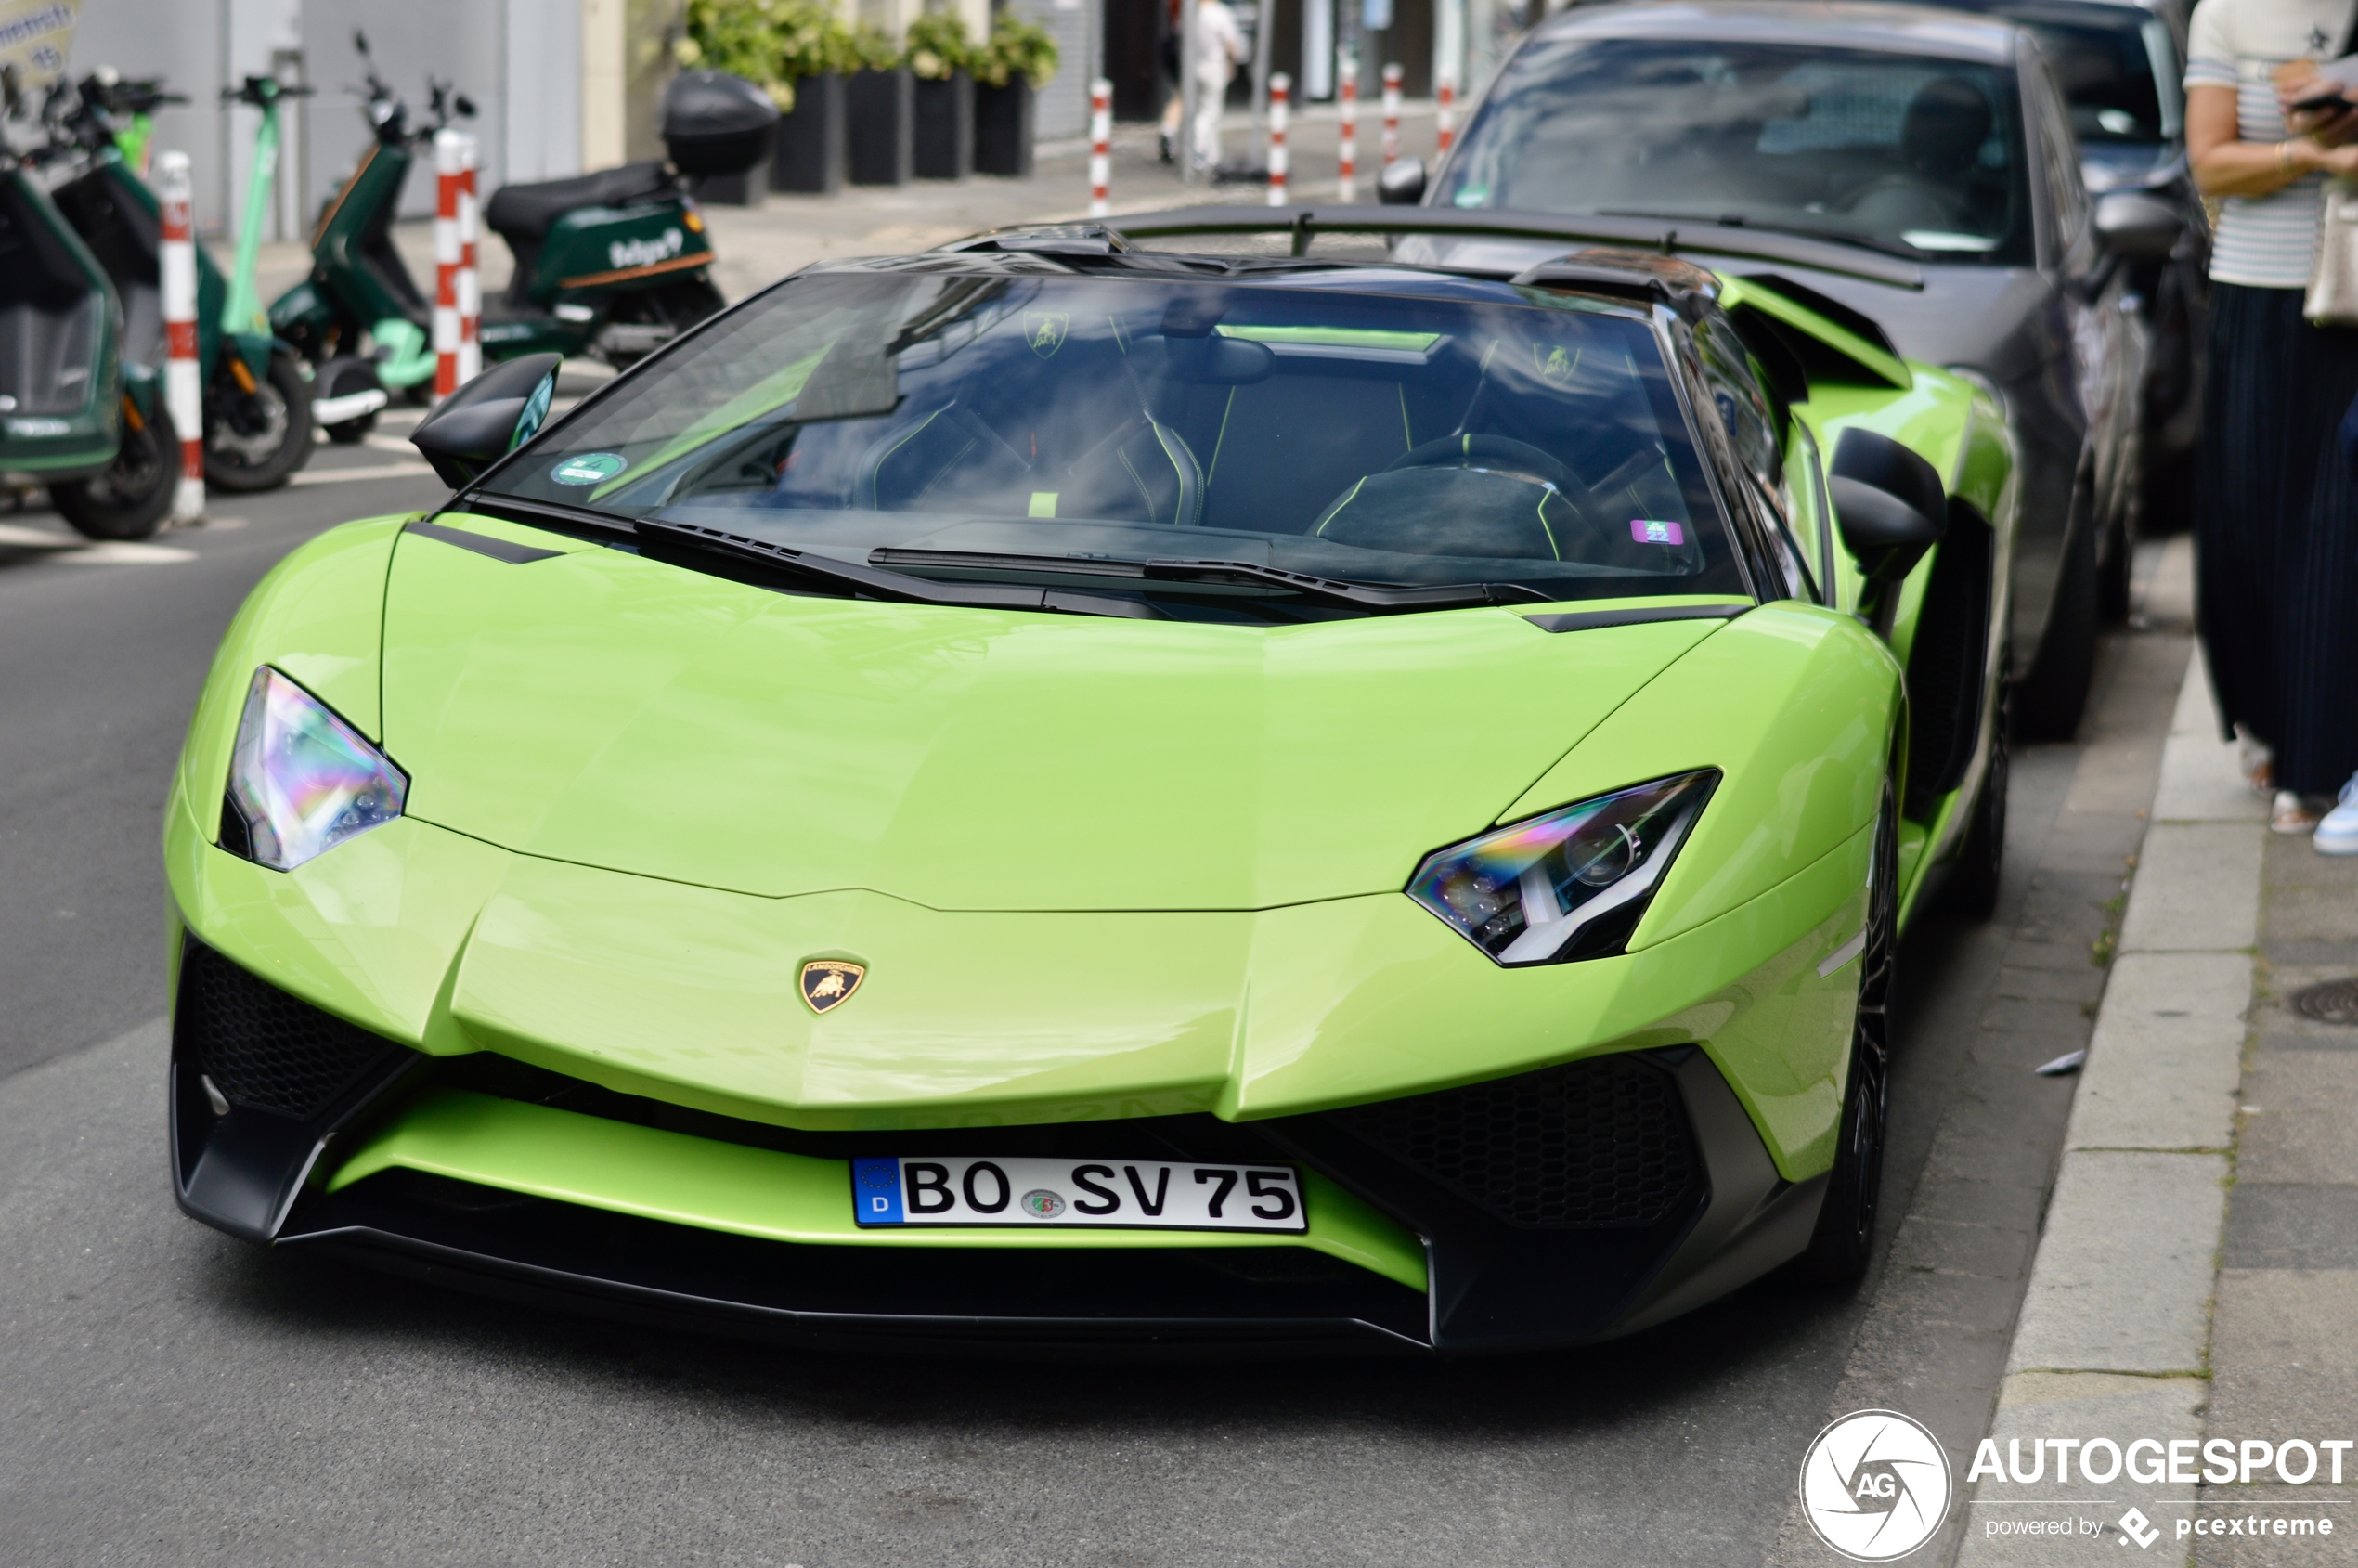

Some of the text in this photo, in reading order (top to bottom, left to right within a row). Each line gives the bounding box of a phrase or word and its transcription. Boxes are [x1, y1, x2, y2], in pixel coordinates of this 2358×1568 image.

[586, 458, 607, 470] 4
[1647, 531, 1669, 542] 22
[904, 1161, 1011, 1214] BO
[1070, 1164, 1171, 1216] SV
[1193, 1168, 1296, 1221] 75
[872, 1197, 888, 1212] D
